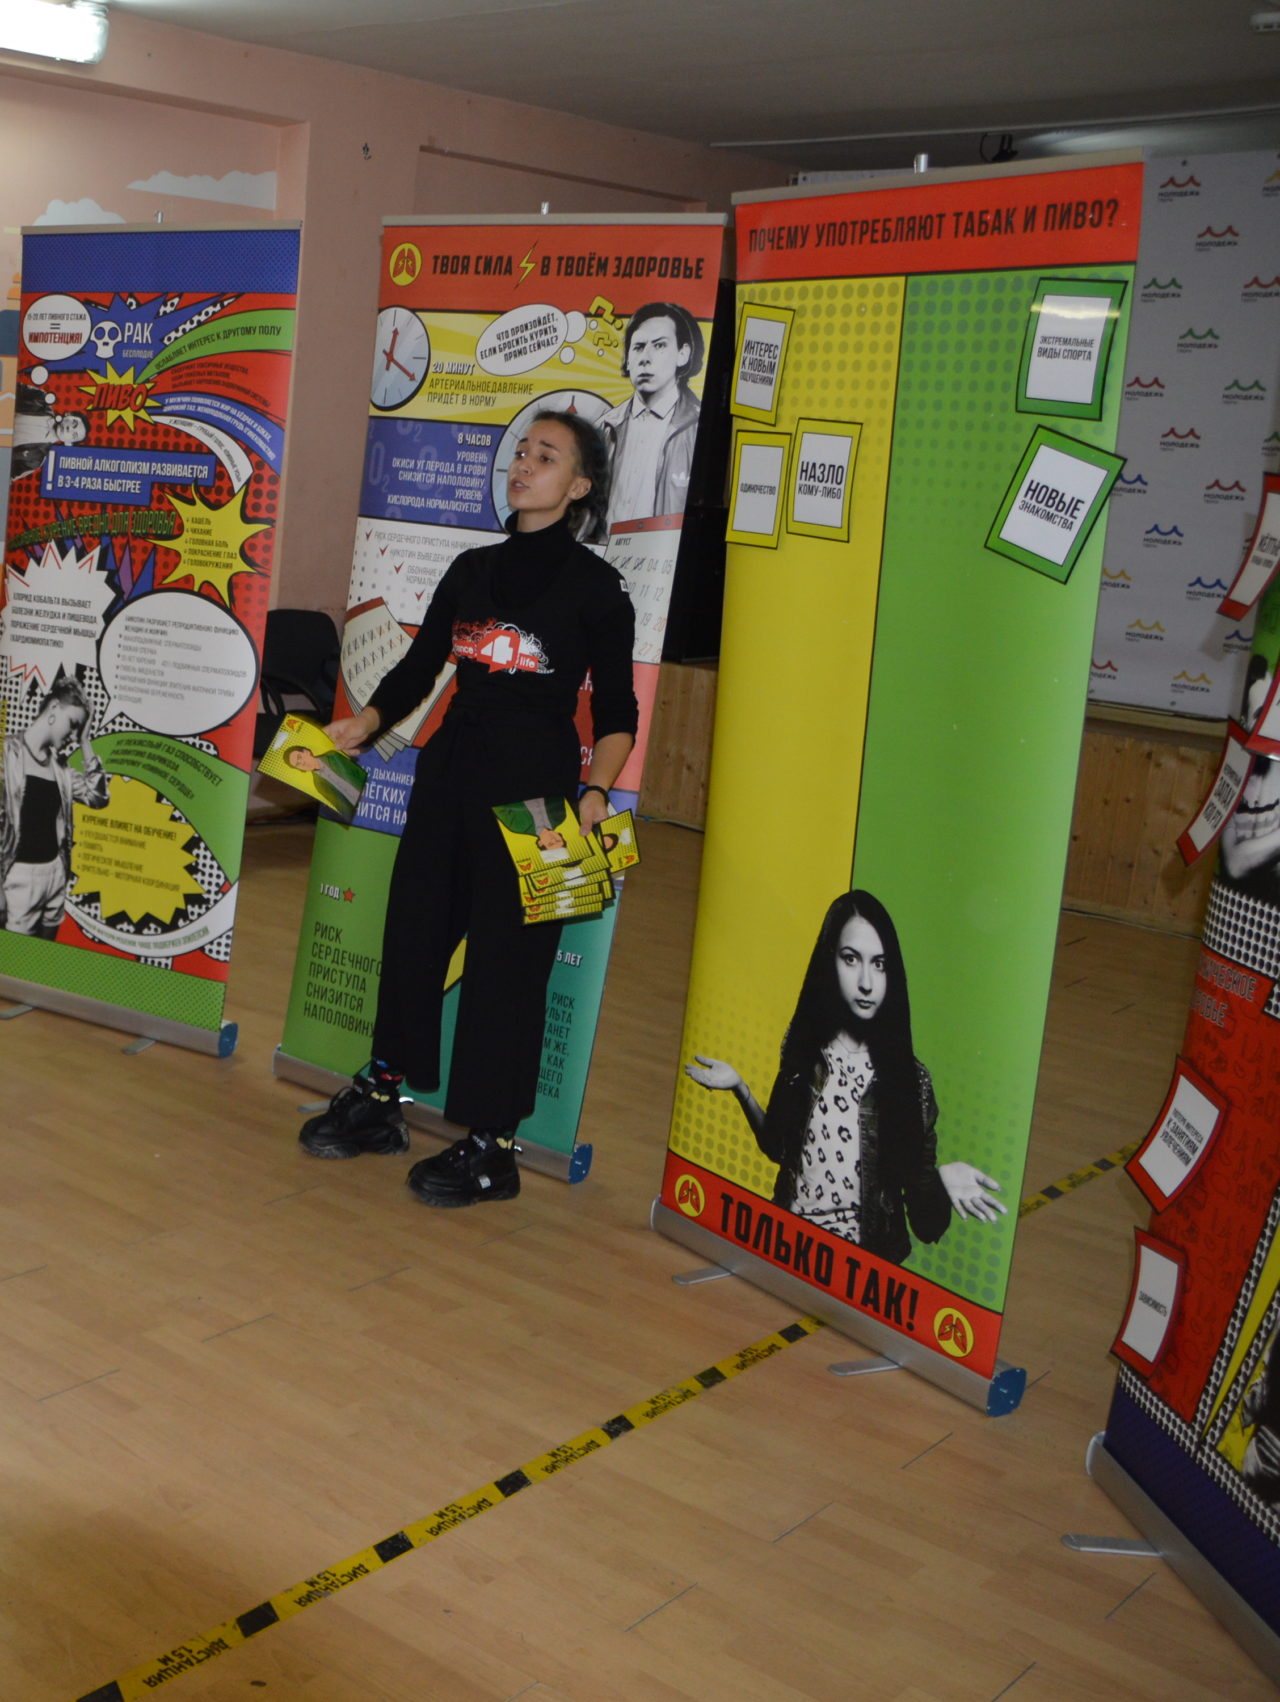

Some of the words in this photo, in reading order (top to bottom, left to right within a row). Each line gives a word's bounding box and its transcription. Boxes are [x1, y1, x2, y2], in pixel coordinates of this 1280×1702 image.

[749, 224, 811, 253] ПОЧЕМУ
[815, 212, 946, 249] УПОТРЕБЛЯЮТ
[953, 206, 1017, 239] ТАБАК
[1023, 205, 1037, 233] И
[1043, 197, 1120, 233] ПИВО?
[432, 255, 471, 275] ТВОЯ
[474, 255, 513, 276] СИЛА
[540, 255, 551, 276] В
[556, 252, 609, 277] ТВОЁМ
[612, 256, 705, 279] ЗДОРОВЬЕ
[28, 332, 83, 345] ИМПОТЕНЦИЯ!
[123, 322, 153, 344] РАК
[188, 333, 216, 351] ИНТЕРЕС
[222, 326, 257, 340] ДРУГОМУ
[258, 325, 282, 336] ПОЛУ
[480, 346, 497, 360] ЕСЛИ
[498, 334, 528, 353] БРОСИТЬ
[529, 324, 557, 341] КУРИТЬ
[496, 329, 510, 341] ЧТО
[1039, 335, 1095, 348] ЭКСТРЕМАЛЬНЫЕ
[504, 346, 528, 363] ПРЯМО
[529, 335, 559, 353] СЕЙЧАС?
[743, 339, 779, 360] ИНТЕРЕС
[1037, 347, 1061, 360] ВИДЫ
[1062, 348, 1092, 361] СПОРТА
[432, 362, 444, 374] 20
[445, 362, 476, 376] МИНУТ
[741, 356, 747, 369] К
[747, 357, 776, 376] НОВЫМ
[740, 371, 774, 387] ОЩУЩЕНИЯМ
[92, 383, 149, 412] ПИВО
[461, 395, 467, 405] В
[469, 395, 497, 407] НОРМУ
[457, 433, 464, 444] 8
[465, 434, 491, 446] ЧАСОВ
[392, 457, 415, 469] ОКИСИ
[416, 459, 455, 473] УГЛЕРОДА
[456, 464, 462, 473] В
[463, 464, 487, 476] КРОВИ
[456, 450, 488, 463] УРОВЕНЬ
[59, 456, 93, 470] ПИВНОЙ
[94, 458, 150, 475] АЛКОГОЛИЗМ
[151, 462, 209, 479] РАЗВИВАЕТСЯ
[398, 470, 435, 484] СНИЗИТСЯ
[799, 460, 845, 486] НАЗЛО
[58, 475, 64, 488] В
[64, 476, 80, 489] 3-4
[80, 477, 102, 490] РАЗА
[103, 478, 142, 493] БЫСТРЕЕ
[740, 482, 777, 496] ОДИНОЧЕСТВО
[798, 484, 842, 500] КОМУ-ЛИБО
[387, 494, 425, 509] КИСЛОРОДА
[426, 498, 482, 514] НОРМАЛИЗУЕТСЯ
[455, 488, 483, 502] УРОВЕНЬ
[1024, 479, 1085, 520] НОВЫЕ
[1018, 499, 1074, 532] ЗНАКОМСТВА
[520, 656, 536, 669] life
[324, 884, 340, 900] ГОД
[314, 920, 343, 945] РИСК
[312, 942, 383, 977] СЕРДЕЧНОГО
[563, 952, 583, 967] ЛЕТ
[309, 961, 367, 994] ПРИСТУПА
[306, 981, 364, 1014] СНИЗИТСЯ
[552, 991, 576, 1010] РИСК
[303, 1001, 376, 1038] НАПОЛОВИНУ
[547, 1054, 565, 1070] КАК
[720, 1192, 835, 1287] ТОЛЬКО
[845, 1256, 920, 1332] ТАК!
[425, 1497, 493, 1537] ДИСТАНЦИЯ
[294, 1563, 370, 1608] ДИСТАНЦИЯ
[142, 1637, 232, 1689] ДИСТАНЦИЯ
[156, 1653, 174, 1666] М
